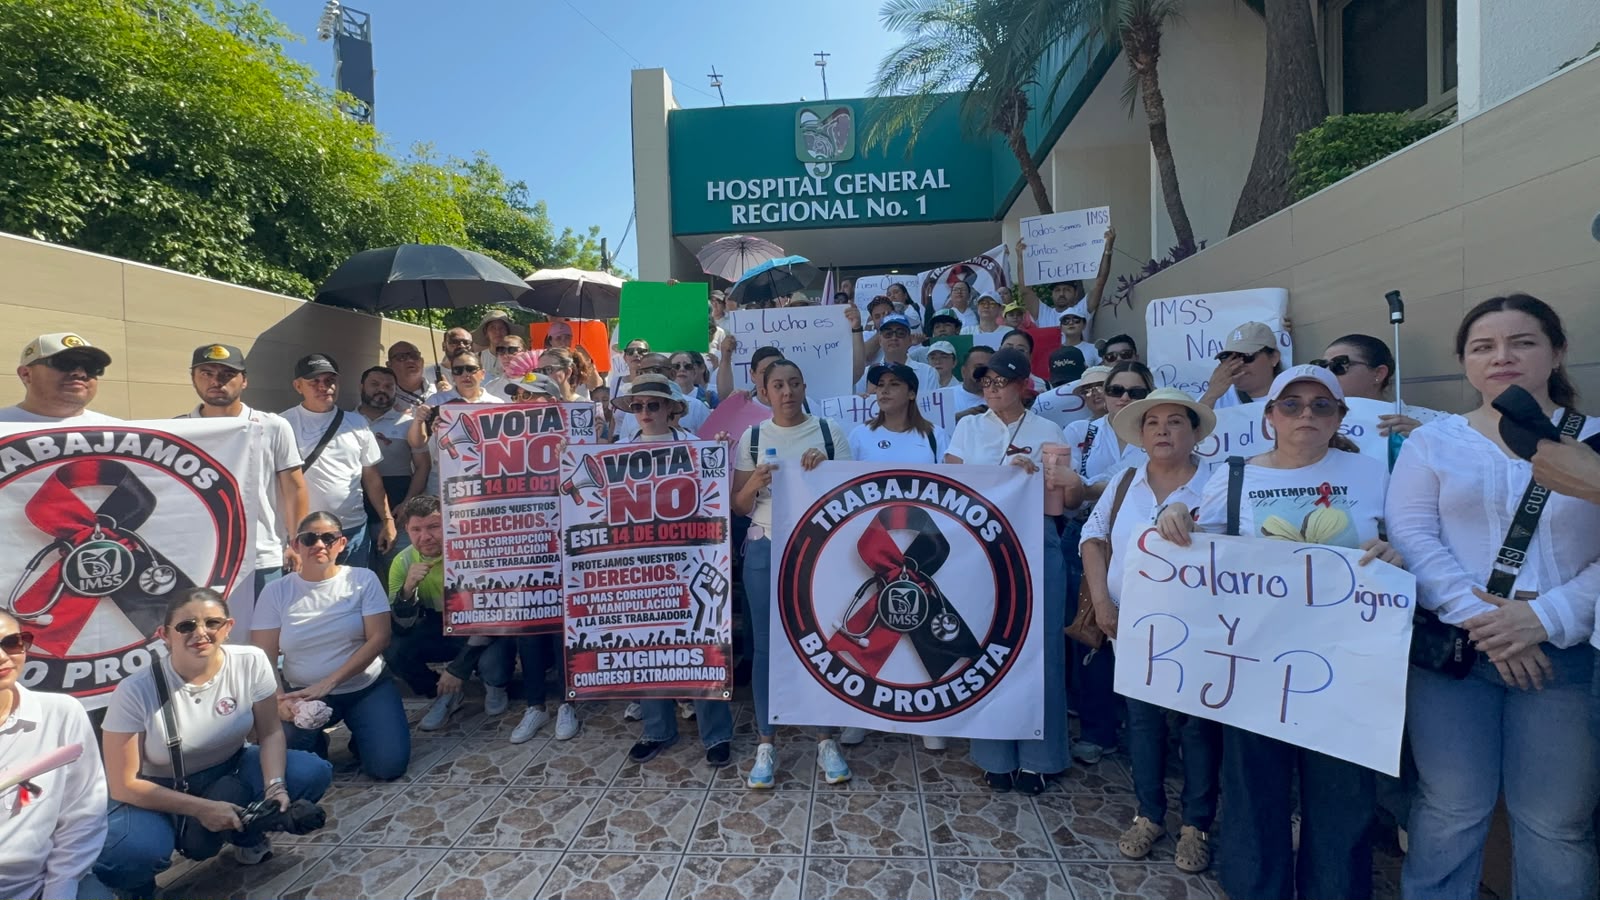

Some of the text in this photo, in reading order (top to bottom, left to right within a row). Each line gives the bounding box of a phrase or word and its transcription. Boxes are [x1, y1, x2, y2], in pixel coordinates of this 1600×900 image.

[707, 168, 950, 200] HOSPITAL GENERAL
[731, 195, 927, 224] REGIONAL No. 1
[1020, 218, 1056, 238] Todos
[1086, 210, 1109, 226] IMSS
[1026, 244, 1058, 257] Juntos
[733, 310, 834, 334] La Lucha es
[1153, 299, 1213, 327] IMSS
[792, 342, 806, 353] mi
[824, 340, 840, 355] por
[479, 406, 565, 440] VOTA
[571, 427, 594, 437] IMSS
[1560, 413, 1583, 437] UESS
[0, 431, 221, 491] ABAJAMOS
[483, 434, 560, 477] NO
[603, 445, 695, 483] VOTA
[702, 469, 726, 478] IMSS
[447, 480, 482, 498] ESTE
[485, 479, 503, 494] 14
[506, 478, 526, 492] DE
[1524, 482, 1548, 515] GUE
[449, 505, 507, 519] PROTEJAMOS
[606, 476, 700, 526] NO
[811, 479, 1003, 543] TRABAJAMOS
[459, 512, 549, 535] DERECHOS,
[570, 521, 723, 548] ESTE 14 DE OCTUBRE
[451, 531, 552, 550] NO MAS CORRUPCIÓN
[463, 542, 548, 559] Y MANIPULACIÓN
[454, 553, 560, 570] A LA BASE TRABAJADORA
[572, 556, 635, 571] PROTEJAMOS
[80, 574, 123, 591] IMSS
[583, 563, 680, 589] DERECHOS,
[1137, 527, 1410, 622] Salario Digno
[572, 583, 683, 606] NO MAS CORRUPCIÓN
[586, 597, 680, 614] Y MANIPULACIÓN
[451, 605, 563, 625] CONGRESO EXTRAORDI
[576, 610, 693, 628] A LA BASE TRABAJADORA
[888, 612, 919, 626] IMSS
[597, 648, 704, 670] EXIGIMOS
[573, 666, 726, 688] CONGRESO EXTRAORDINARIO
[798, 631, 1012, 713] BAJO PROTESTA
